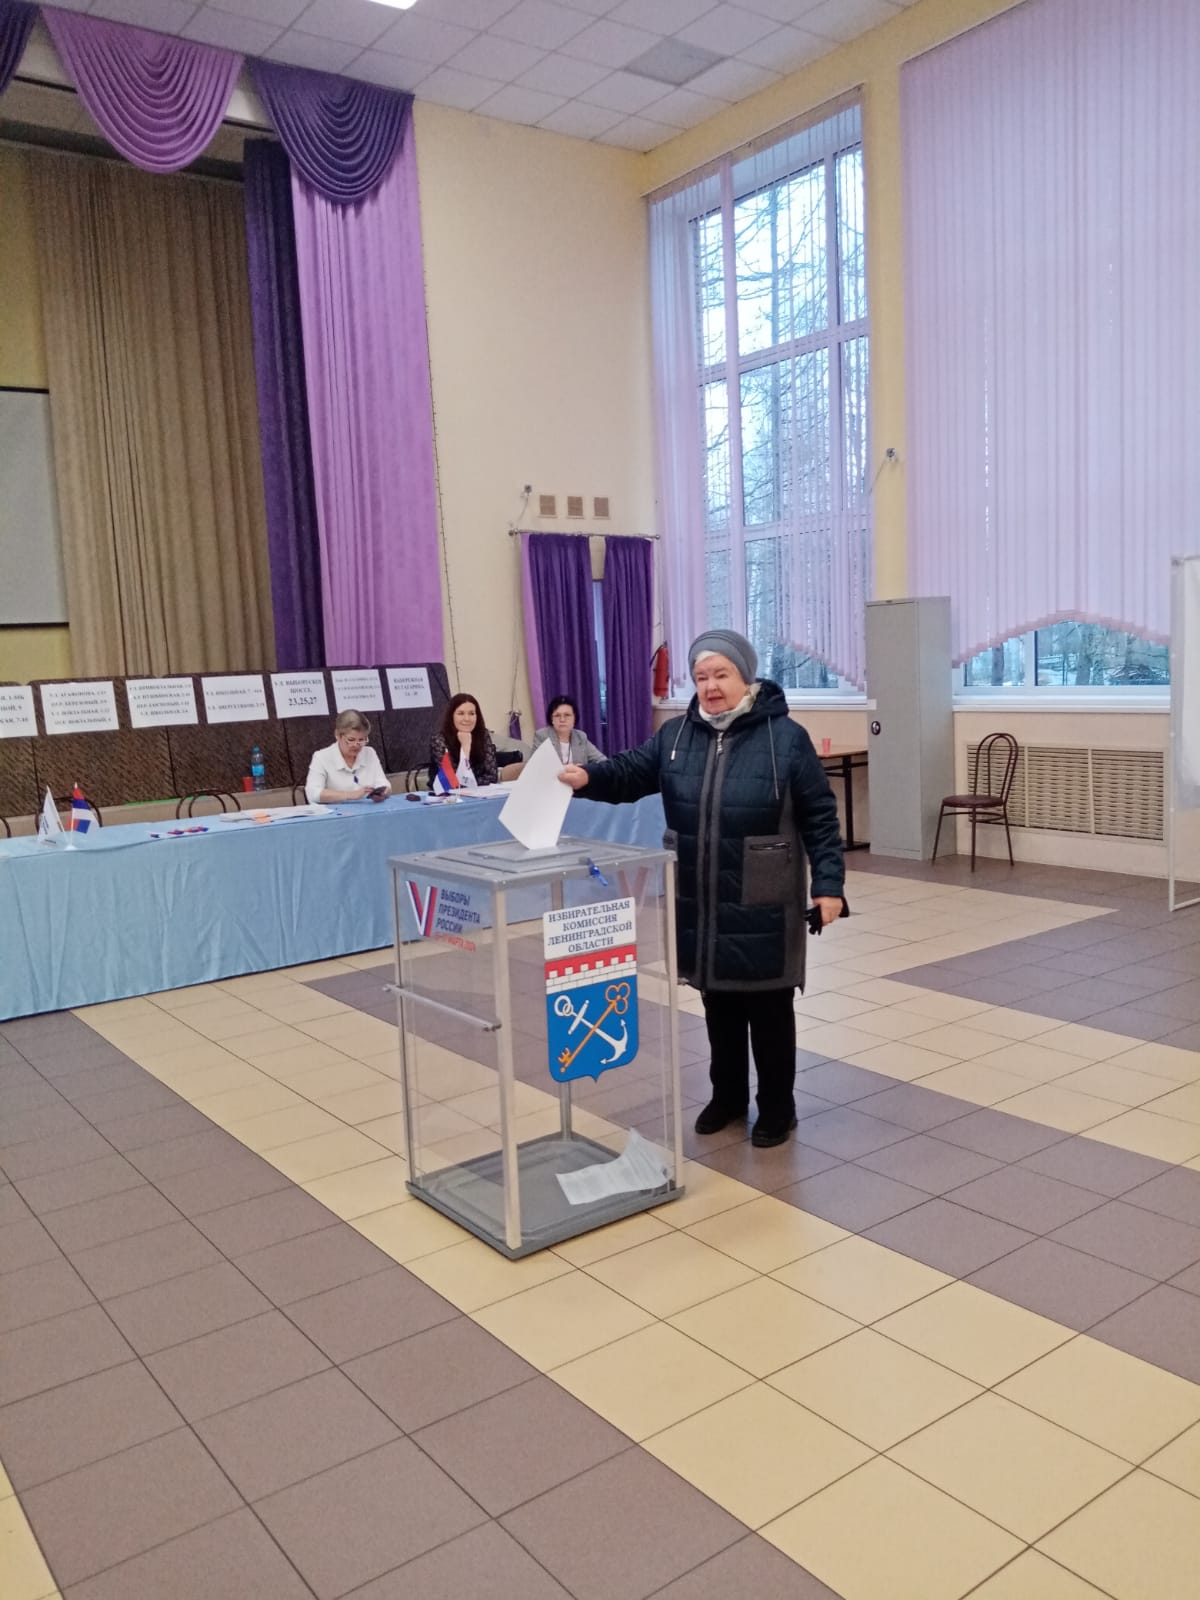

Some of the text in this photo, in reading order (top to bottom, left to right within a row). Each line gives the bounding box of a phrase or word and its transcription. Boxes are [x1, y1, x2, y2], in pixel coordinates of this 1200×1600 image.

[288, 696, 318, 706] 23,25,27
[441, 888, 471, 906] ВЫБОРЫ
[438, 903, 481, 924] ПРЕЗИДЕНТА
[548, 900, 631, 923] ИЗБИРАТЕЛЬНАЯ
[435, 917, 463, 934] РОССИИ
[563, 914, 618, 932] КОМИССИЯ
[547, 921, 633, 946] ЛЕНИНГРАДСКОЙ
[568, 936, 614, 953] ОБЛАСТИ
